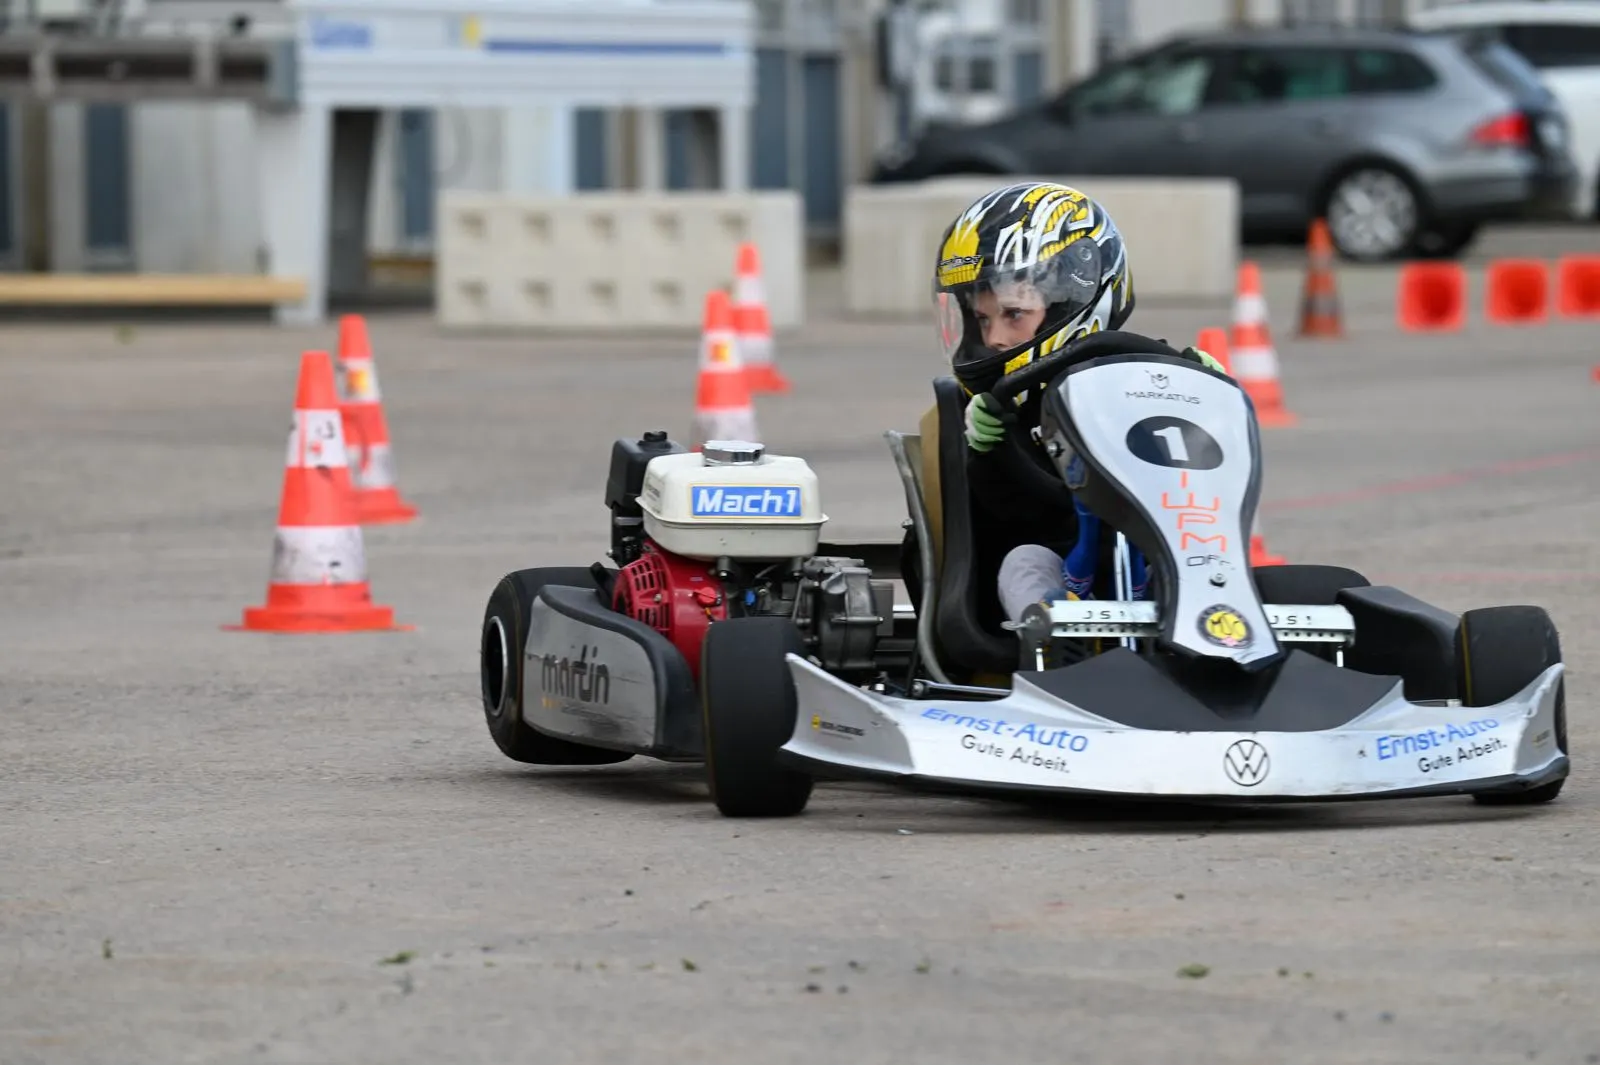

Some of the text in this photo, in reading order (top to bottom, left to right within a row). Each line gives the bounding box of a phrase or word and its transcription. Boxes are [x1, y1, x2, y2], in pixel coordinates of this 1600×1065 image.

[1125, 391, 1201, 405] MARKATUS
[1152, 426, 1190, 462] 1
[696, 488, 798, 514] Mach1
[921, 708, 1090, 753] Ernst-Auto
[1376, 719, 1499, 761] Ernst-Auto
[961, 734, 1071, 774] Gute Arbeit.
[1418, 756, 1454, 773] Gute
